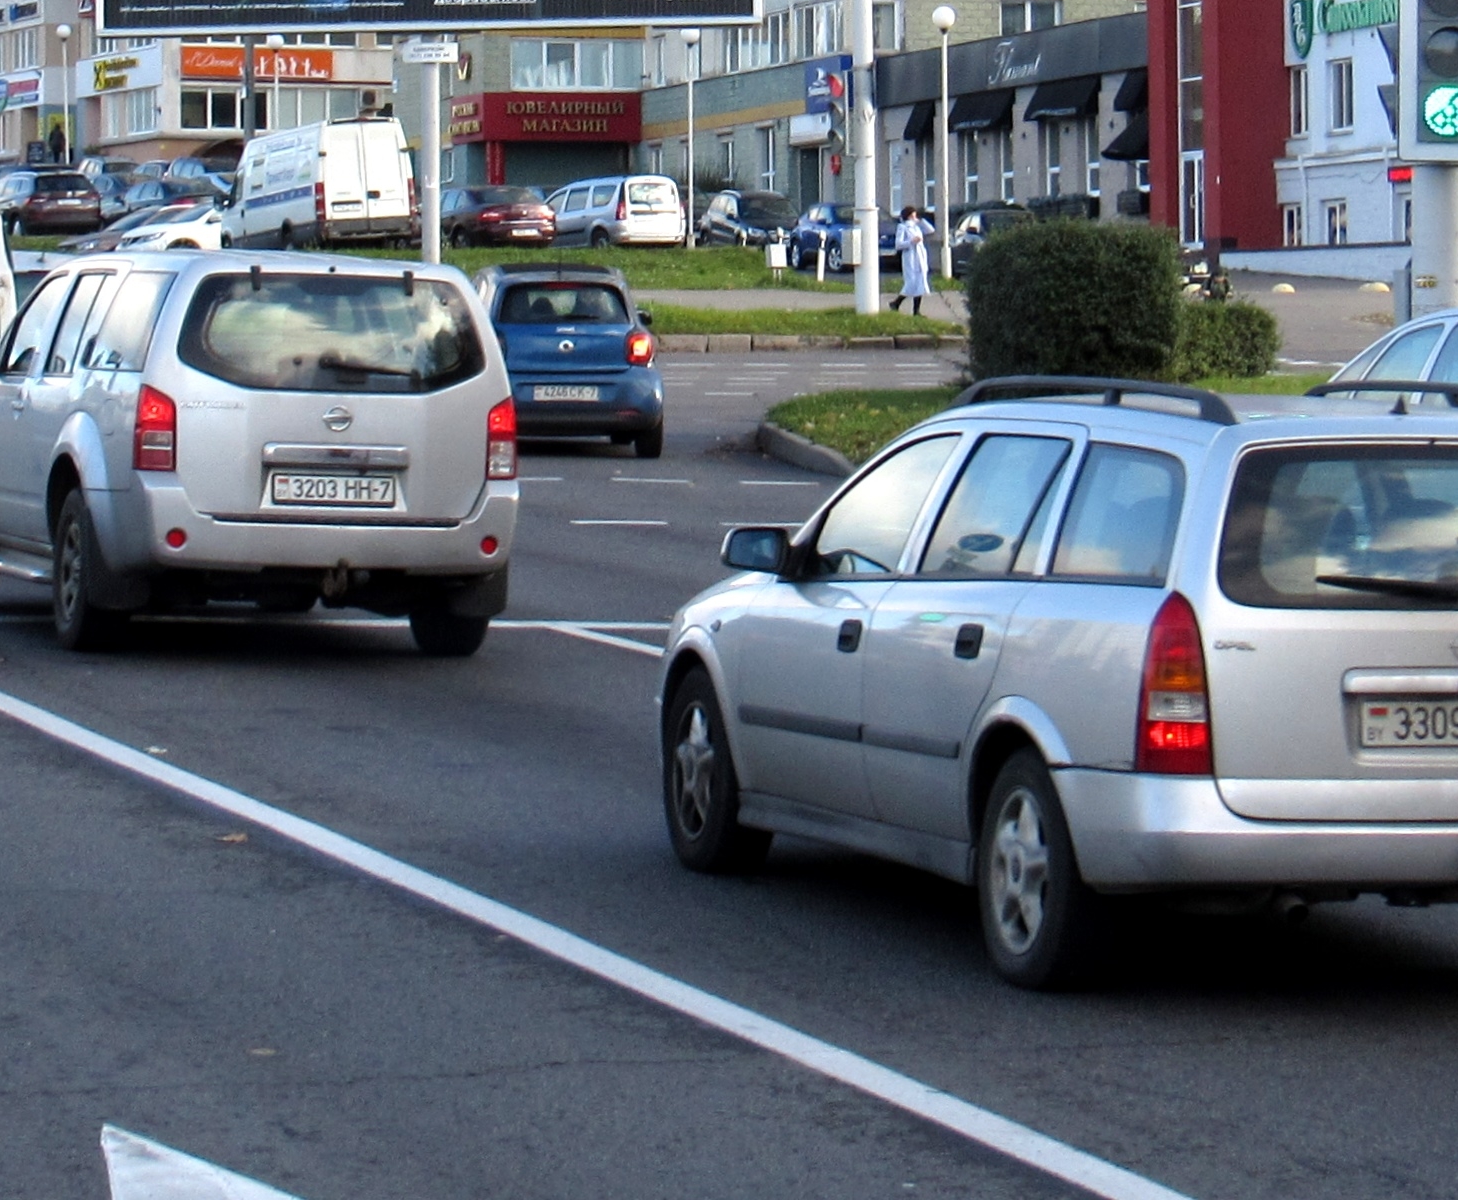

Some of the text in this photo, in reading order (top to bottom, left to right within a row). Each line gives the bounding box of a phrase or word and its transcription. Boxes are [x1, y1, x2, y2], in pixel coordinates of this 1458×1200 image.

[506, 99, 624, 116] ЮВЕЛИРНЫЙ
[522, 118, 608, 133] МАГАЗИН
[293, 479, 391, 500] 3203 HH-7
